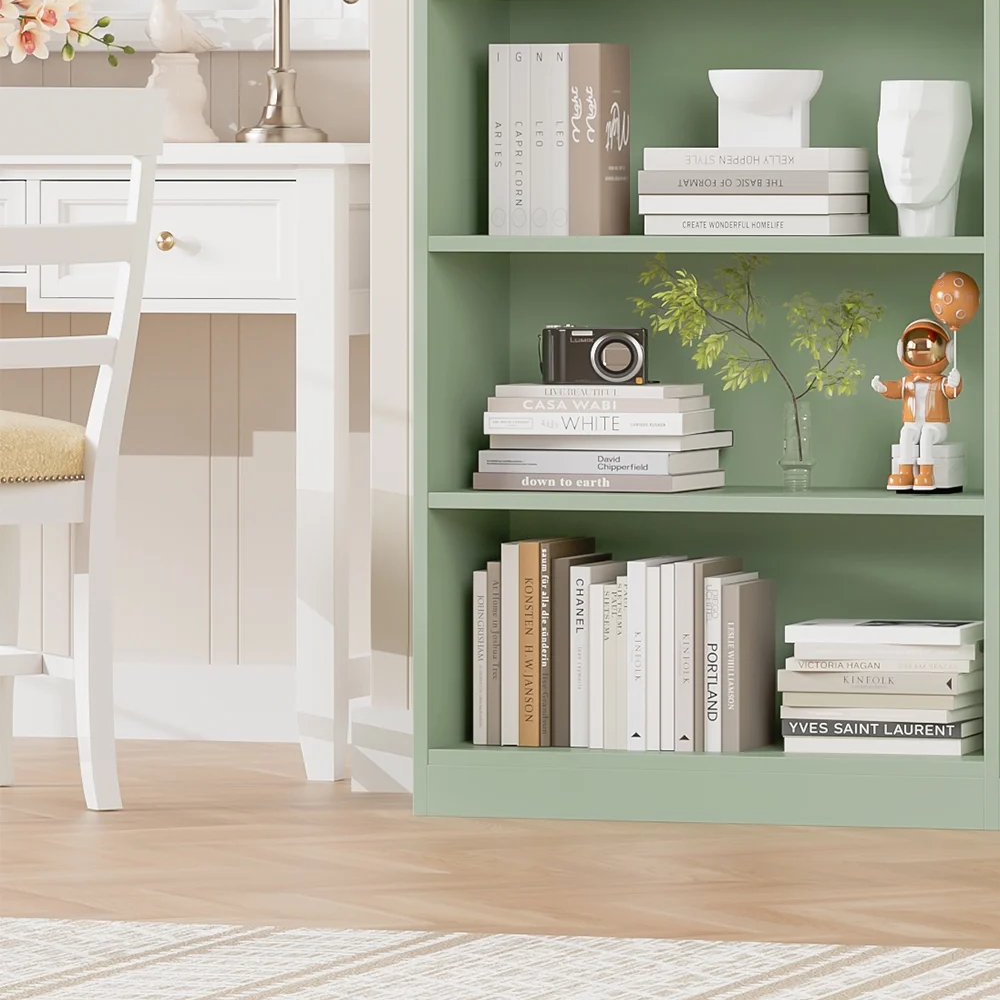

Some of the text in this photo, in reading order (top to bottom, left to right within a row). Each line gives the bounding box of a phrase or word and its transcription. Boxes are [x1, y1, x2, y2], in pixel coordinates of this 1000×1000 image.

[556, 121, 564, 147] LEO
[494, 122, 502, 167] ARIES
[515, 122, 523, 206] CAPRICORN
[685, 155, 795, 165] KELLY HOPPEN STYLE
[678, 179, 783, 187] THE BASIC OF FORMAT
[682, 221, 707, 229] CREATE
[709, 221, 749, 229] WONDERFUL
[522, 400, 617, 410] CASA WABI
[560, 416, 620, 431] WHITE
[597, 455, 621, 463] David
[597, 463, 649, 472] Chipperfield
[521, 476, 610, 488] down to earth
[541, 548, 549, 571] saum
[541, 575, 549, 588] für
[541, 591, 549, 607] alla
[576, 578, 584, 634] CHANEL
[524, 578, 534, 635] KONSTEN
[541, 610, 549, 624] die
[798, 661, 844, 669] VICTORIA
[707, 643, 718, 722] PORTLAND
[843, 675, 895, 684] KINFOLK
[789, 722, 955, 736] YVES SAINT LAURENT
